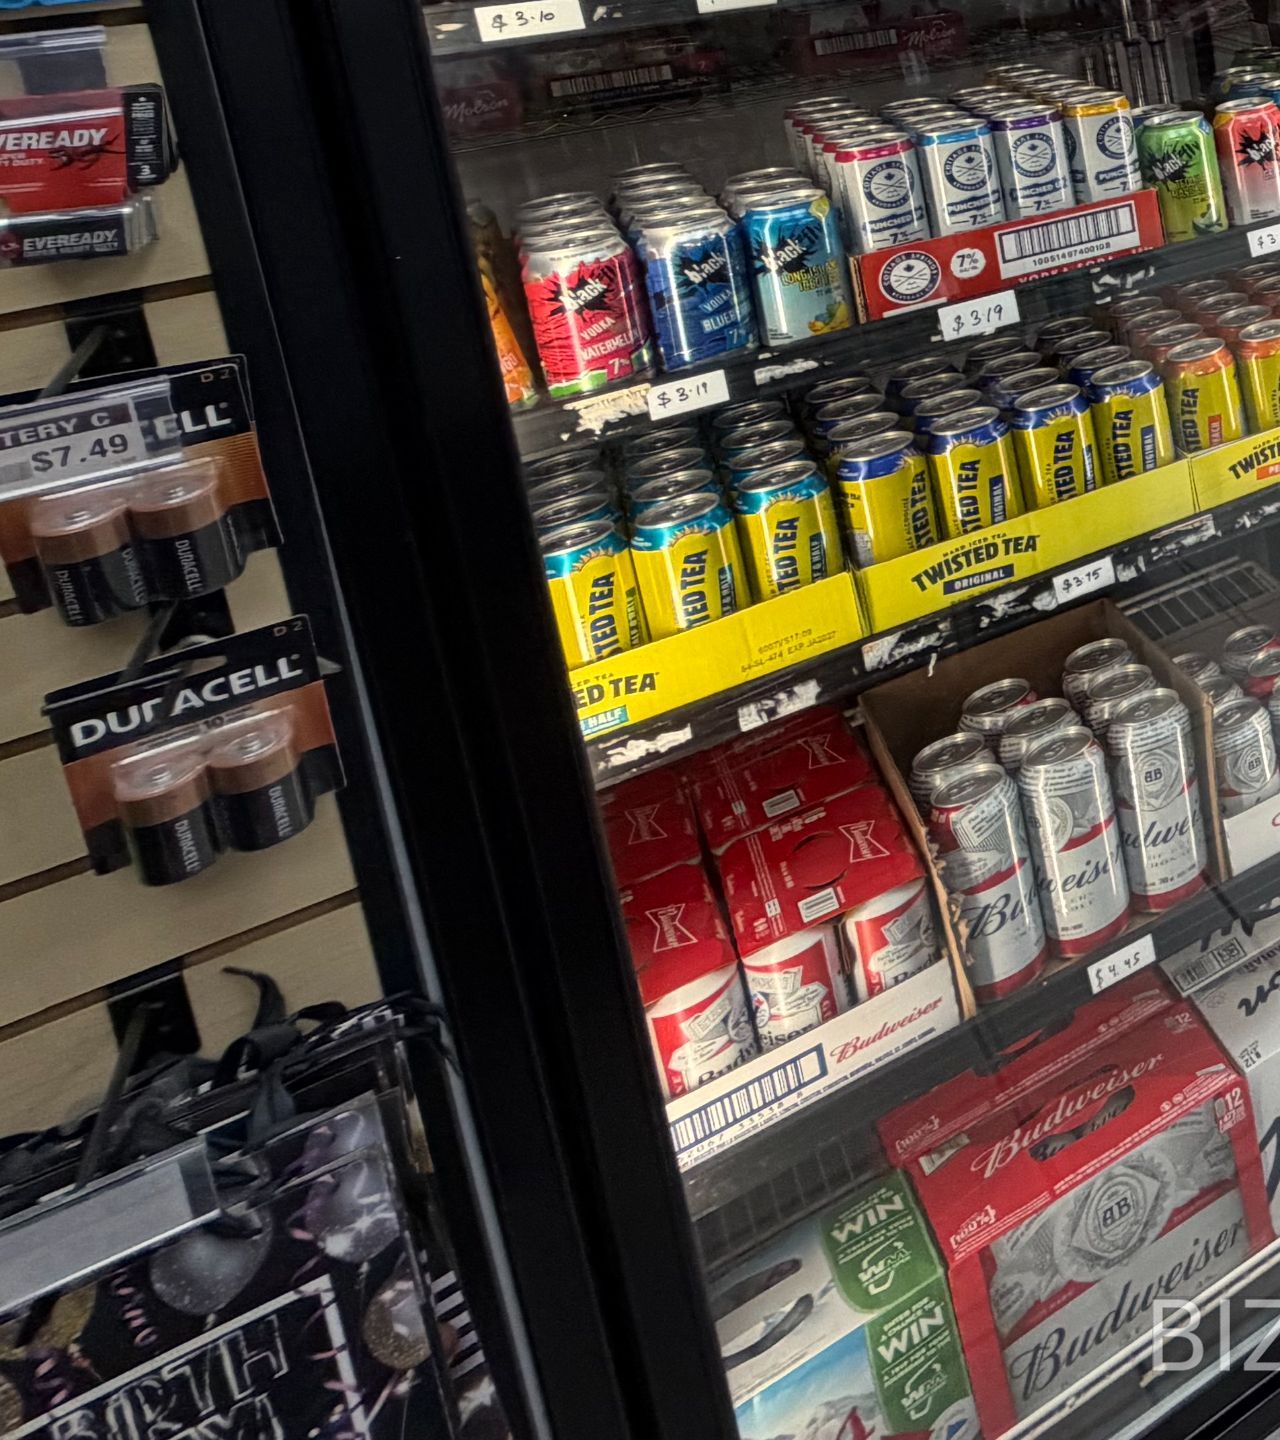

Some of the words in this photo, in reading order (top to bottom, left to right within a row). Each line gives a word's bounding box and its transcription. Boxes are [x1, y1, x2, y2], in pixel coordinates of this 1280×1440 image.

[491, 9, 556, 34] $3.10
[23, 229, 118, 251] EVEREADY
[684, 251, 728, 284] black
[956, 251, 978, 268] 7%
[702, 289, 734, 313] VODKA
[580, 316, 617, 341] VODKA
[658, 381, 709, 408] $3.19
[91, 412, 112, 428] C
[31, 434, 130, 473] $7.49
[175, 538, 201, 594] DURACELL
[911, 541, 1000, 593] TWISTED
[1003, 534, 1041, 557] TEA
[954, 567, 1006, 591] ORIGINAL
[611, 671, 661, 694] TEA
[589, 708, 623, 728] HALF
[268, 784, 293, 839] DURACELL
[174, 818, 200, 873] DURACELL
[829, 996, 943, 1063] Budweiser
[970, 1052, 1165, 1179] Budweiser
[831, 1191, 905, 1246] WIN
[1101, 1195, 1133, 1231] AB
[1009, 1217, 1248, 1403] Budweiser
[877, 1306, 946, 1364] WIN
